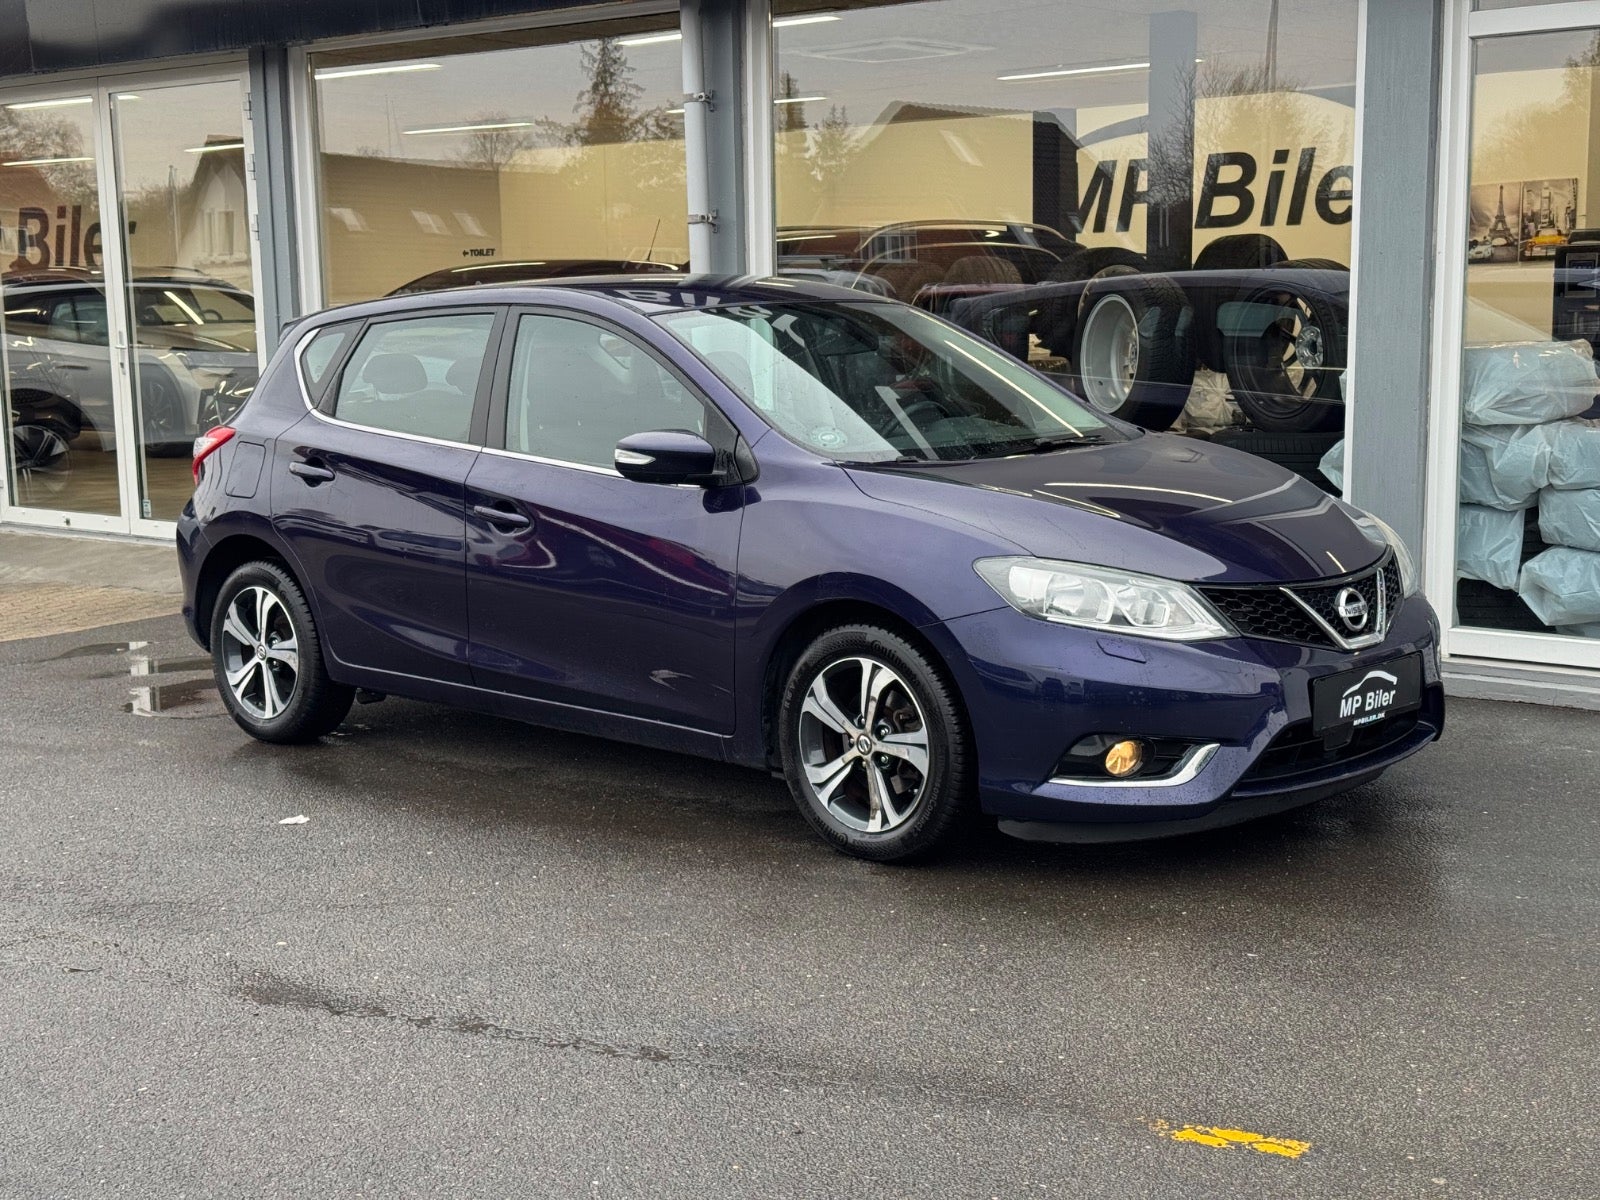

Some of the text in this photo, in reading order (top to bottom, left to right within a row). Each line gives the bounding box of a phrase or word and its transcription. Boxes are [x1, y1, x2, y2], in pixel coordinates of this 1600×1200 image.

[18, 204, 137, 269] Bile
[469, 248, 496, 256] TOILET
[1339, 689, 1396, 719] MP Biler
[1353, 711, 1386, 726] MPBILER.DK
